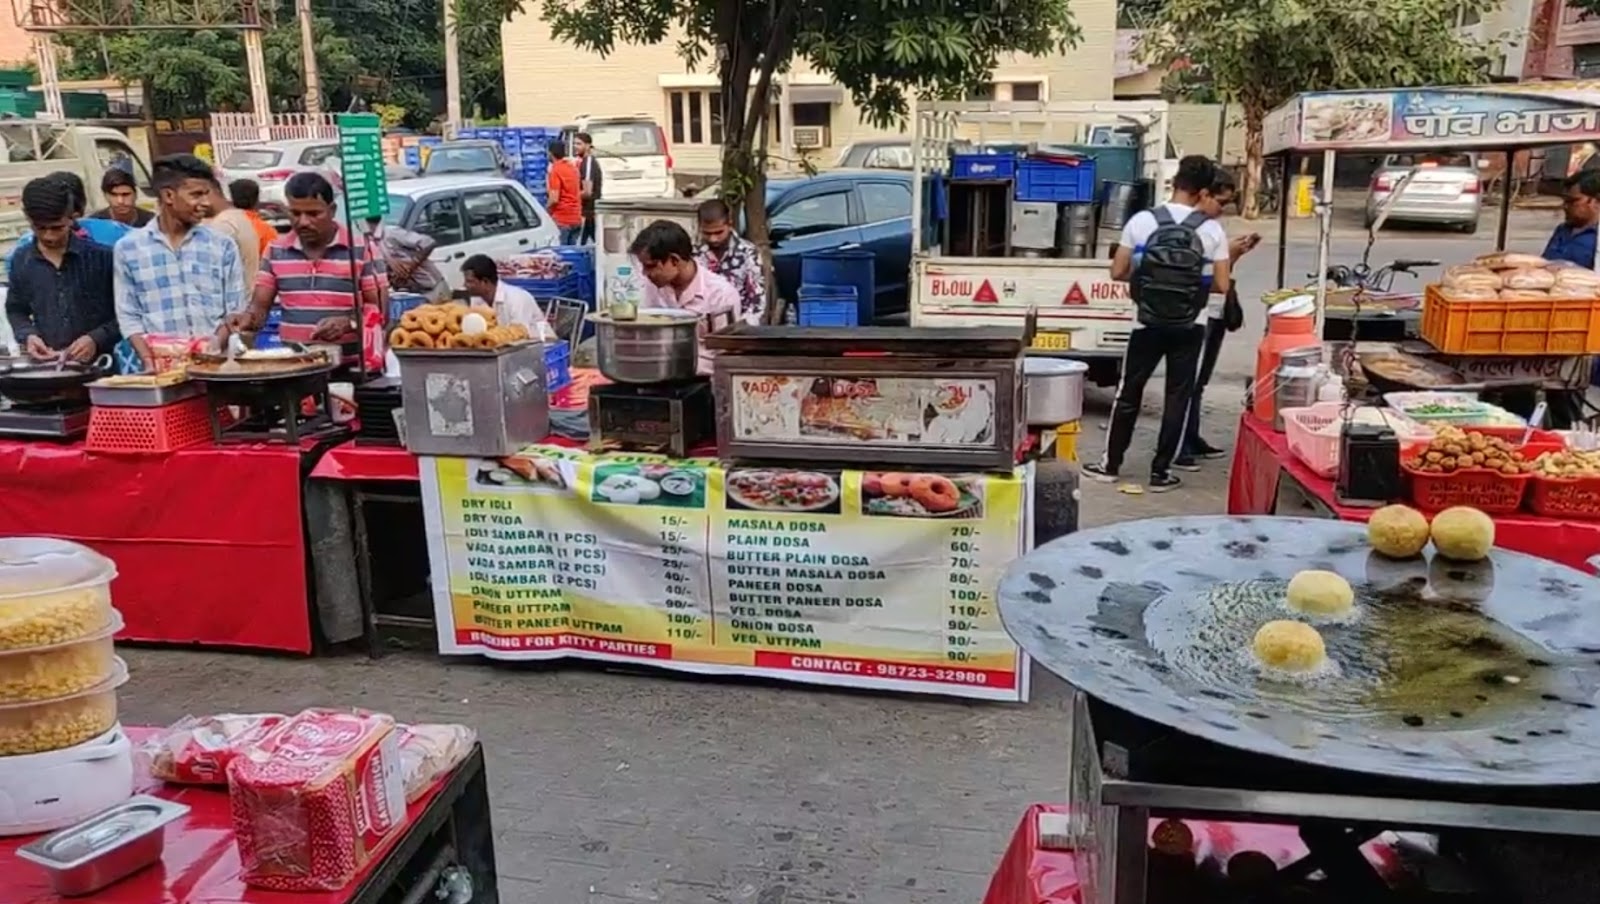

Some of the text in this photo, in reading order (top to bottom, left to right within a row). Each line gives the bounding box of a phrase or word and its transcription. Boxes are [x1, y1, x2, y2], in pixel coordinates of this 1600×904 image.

[1494, 107, 1599, 135] भाज
[931, 280, 972, 296] BLOW
[1090, 282, 1131, 299] HORN
[741, 381, 780, 395] VADA
[462, 499, 688, 527] DRY IDLI 15/-
[463, 514, 688, 542] DRY VADA 15/-
[465, 528, 488, 538] IDLI
[492, 530, 545, 540] SAMBAR
[548, 532, 559, 542] (1
[565, 533, 597, 545] PCS)
[728, 519, 980, 538] MASALA DOSA 70/-
[498, 545, 554, 555] SAMBAR
[557, 548, 567, 558] (1
[574, 548, 606, 560] PCS)
[728, 534, 979, 553] PLAIN DOSA 60/-
[498, 559, 555, 570] SAMBAR
[559, 562, 570, 572] (2
[574, 563, 606, 575] PCS)
[664, 572, 691, 582] 40/-
[727, 551, 979, 569] BUTTER PLAIN DOSA 70/-
[492, 574, 547, 585] SAMBAR
[553, 575, 564, 584] (2
[568, 577, 597, 589] PCS)
[665, 585, 692, 595] 40/-
[728, 565, 979, 585] BUTTER MASALA DOSA 80/-
[506, 588, 562, 599] UTTPAM
[665, 599, 694, 609] 90/-
[728, 579, 988, 601] PANEER DOSA 100/-
[517, 602, 571, 614] UTTPAM
[666, 613, 701, 624] 100/-
[729, 593, 987, 617] BUTTER PANEER DOSA 110/-
[517, 617, 569, 629] PANEER
[572, 620, 623, 634] UTTPAM
[667, 628, 703, 639] 110/-
[730, 606, 979, 631] VEG. DOSA 90/-
[731, 619, 978, 647] ONION DOSA 90/-
[525, 636, 556, 647] FOR
[559, 635, 596, 648] KITTY
[600, 641, 657, 656] PARTIES
[731, 632, 978, 662] VEG. UTTPAM 90/-
[791, 656, 862, 673] CONTACT
[877, 663, 987, 684] 98723-32980
[371, 756, 391, 829] SANDWICH
